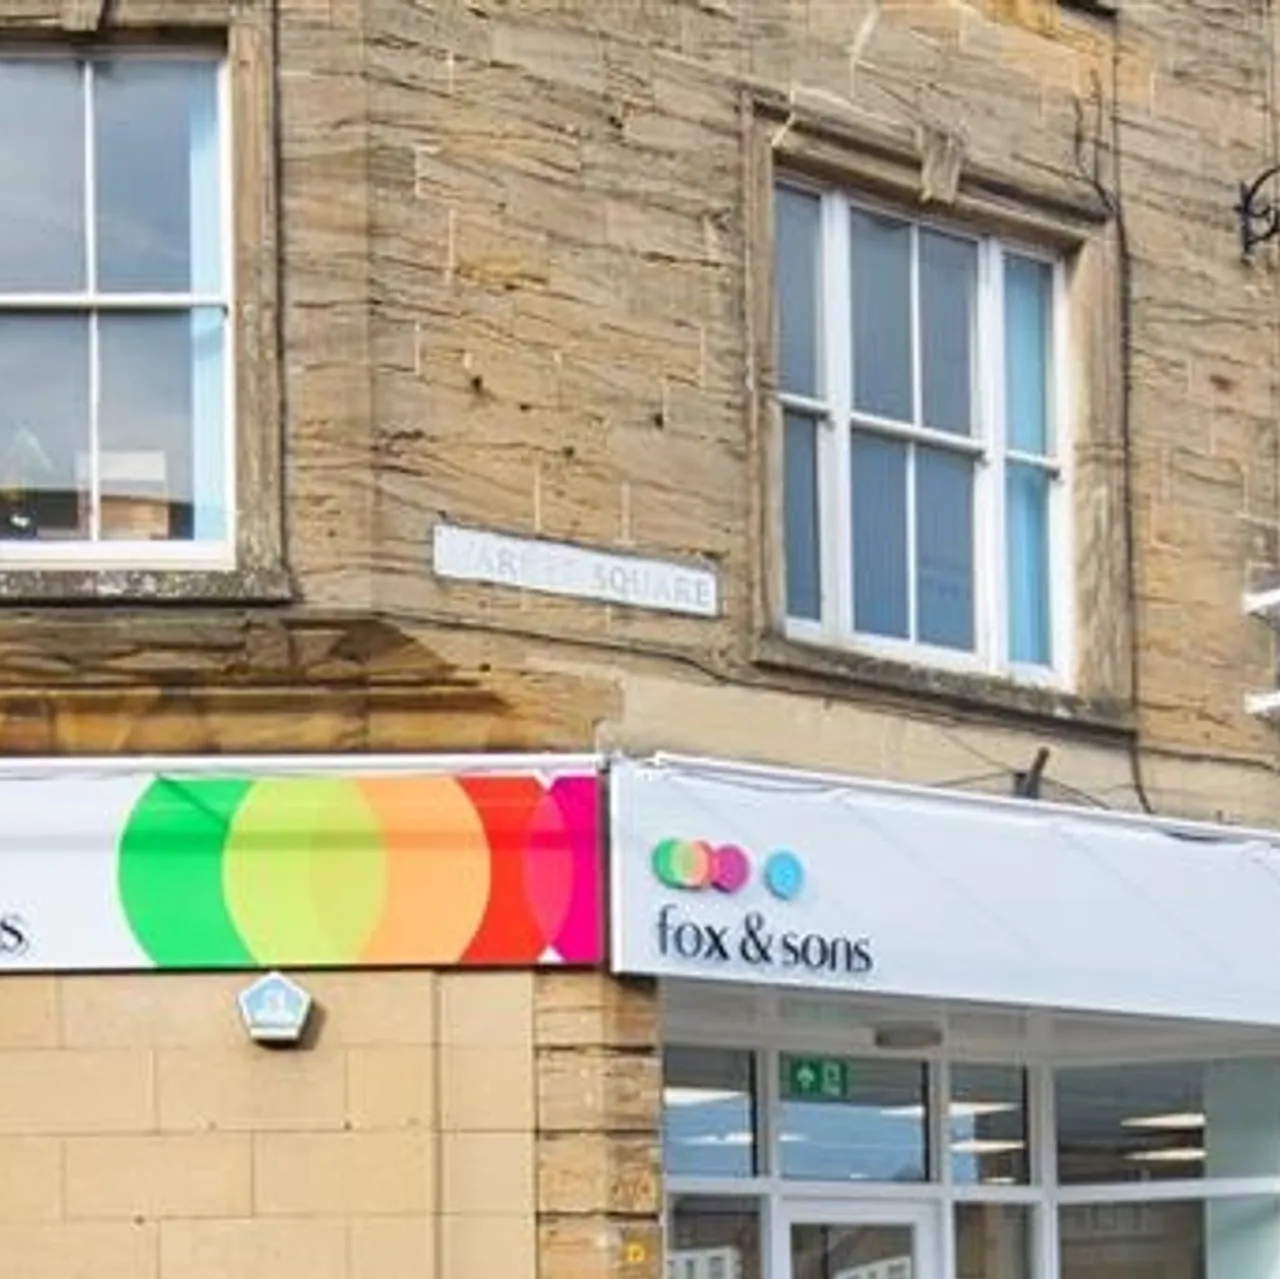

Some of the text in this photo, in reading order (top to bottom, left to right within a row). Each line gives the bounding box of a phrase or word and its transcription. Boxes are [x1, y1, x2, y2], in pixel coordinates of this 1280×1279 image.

[658, 905, 873, 972] fox & sons
